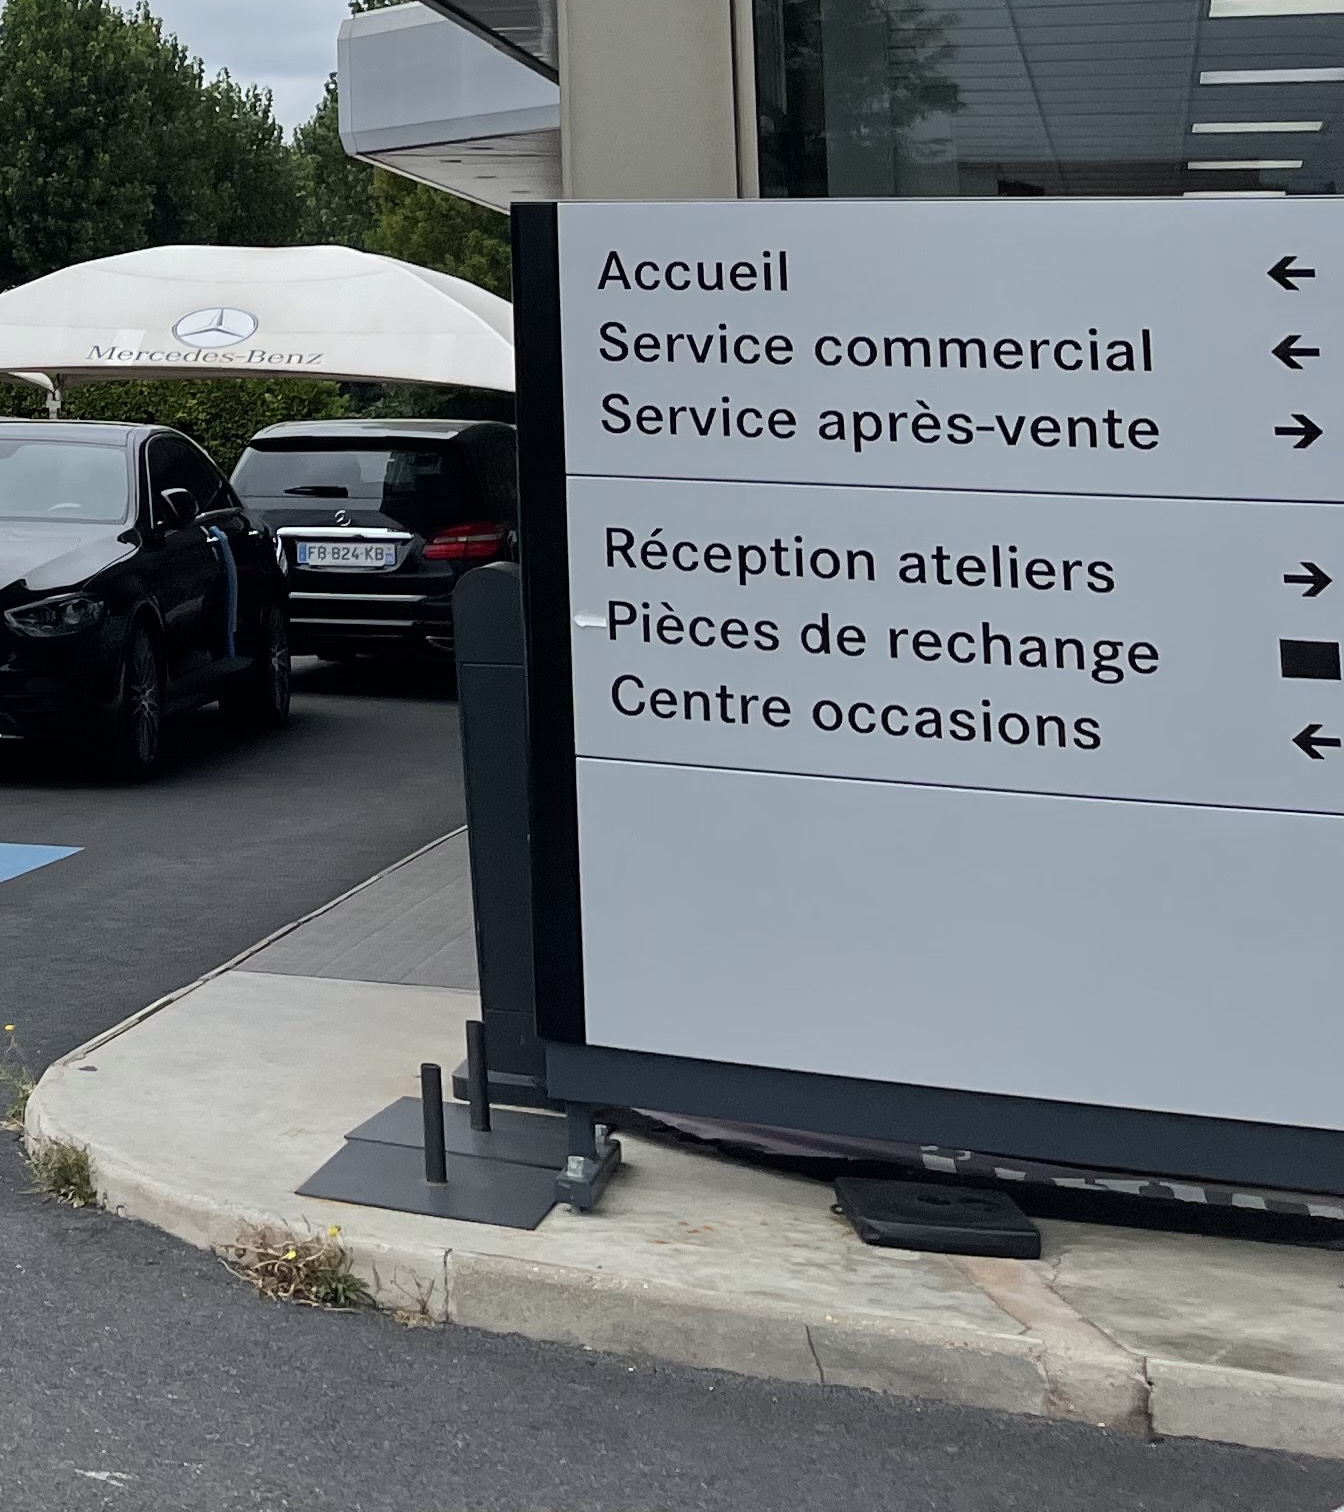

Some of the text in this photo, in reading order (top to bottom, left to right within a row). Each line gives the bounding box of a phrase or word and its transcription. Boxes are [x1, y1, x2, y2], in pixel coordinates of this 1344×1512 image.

[598, 251, 788, 292] Accueil
[85, 345, 325, 364] Mercedes-Benz
[599, 322, 1152, 372] Service commercial
[601, 394, 1160, 452] Service après-vente
[606, 527, 1115, 593] Réception ateliers
[607, 601, 1160, 684] Pièces de rechange
[611, 675, 1102, 750] Centre occasions
